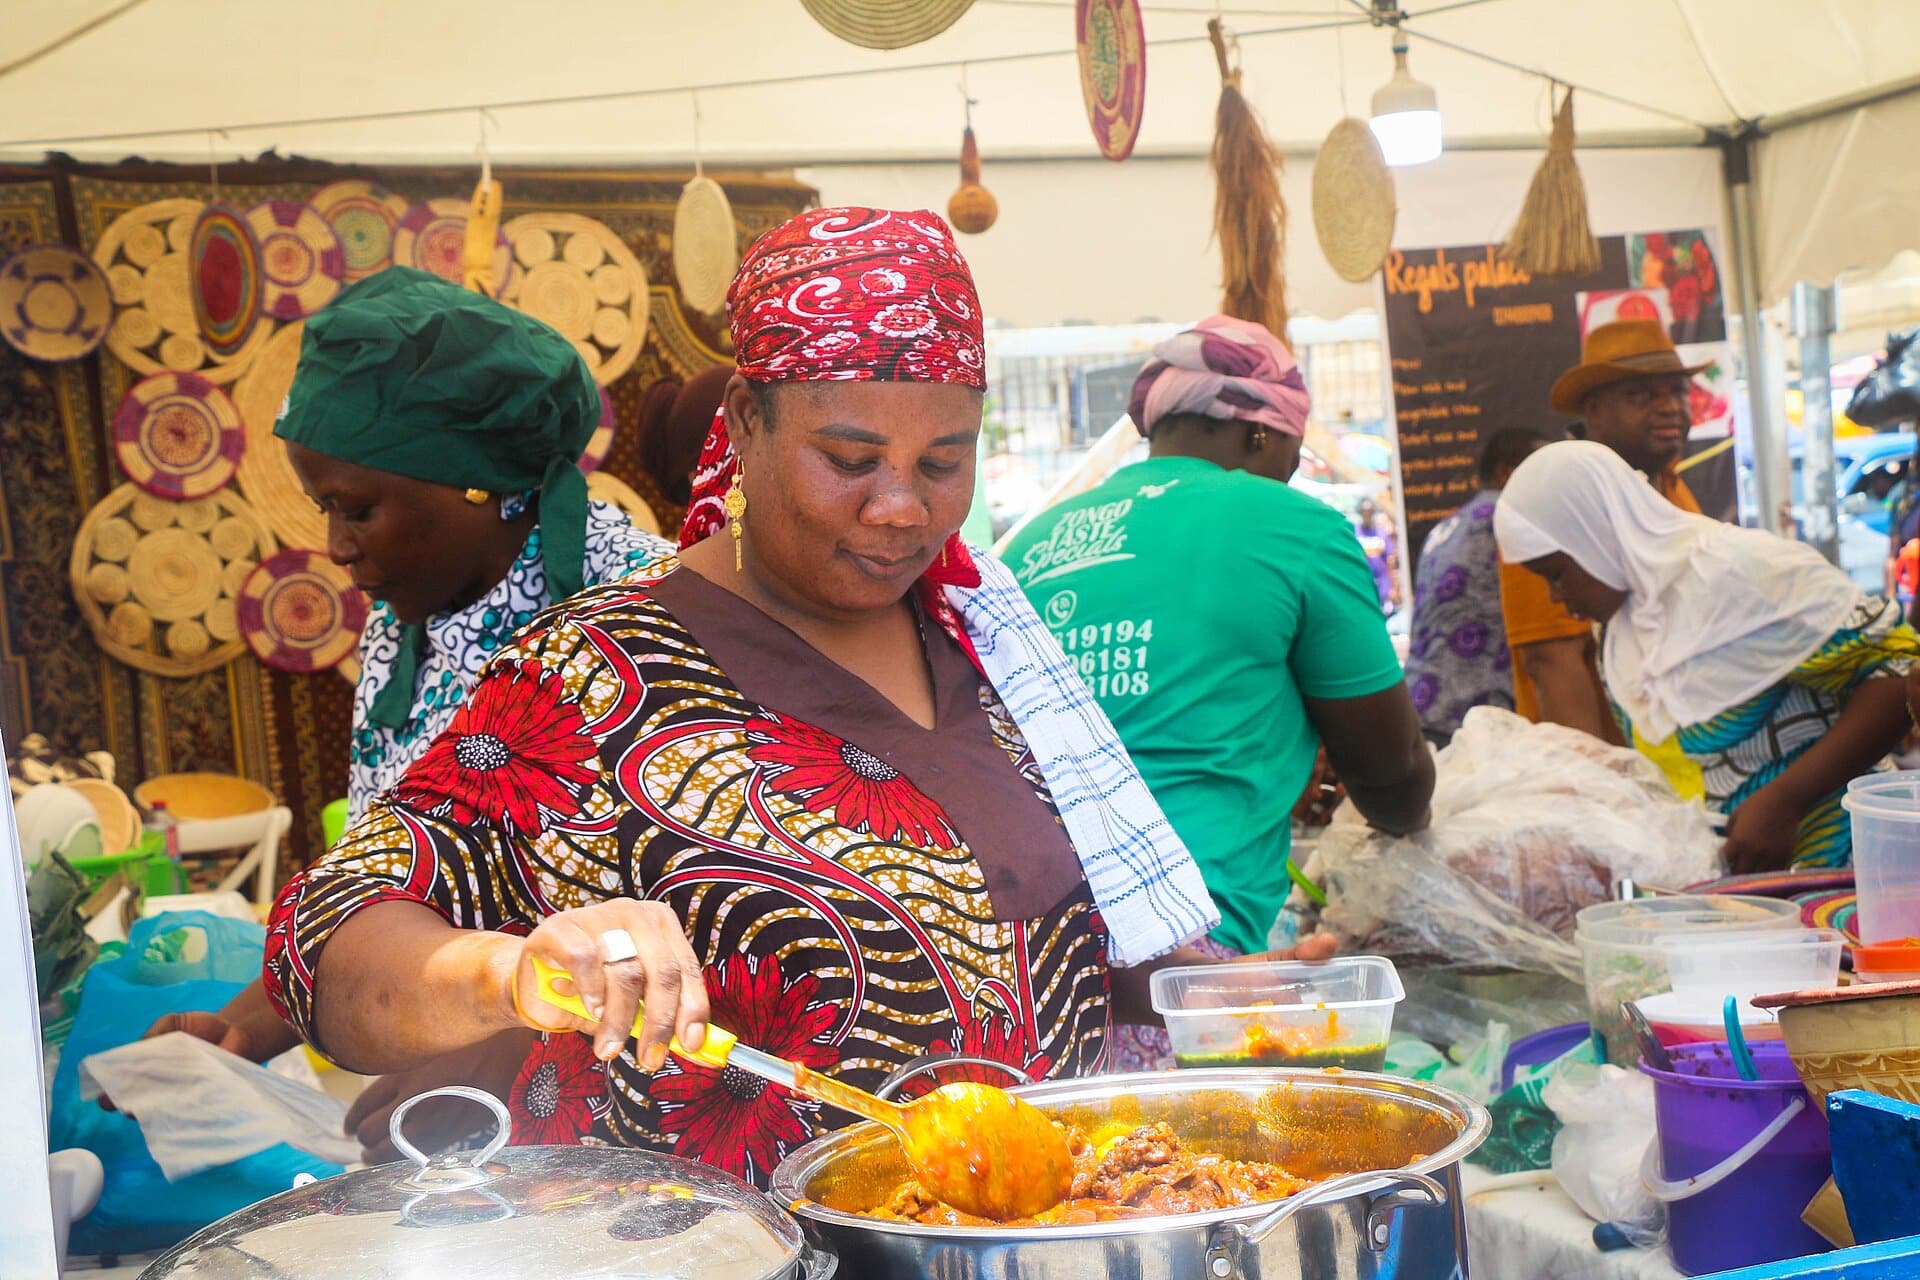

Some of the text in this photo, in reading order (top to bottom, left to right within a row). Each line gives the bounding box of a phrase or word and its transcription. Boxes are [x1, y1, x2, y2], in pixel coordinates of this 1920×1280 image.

[1384, 248, 1460, 314] Regals
[1049, 519, 1116, 552] TASTE
[1057, 499, 1133, 528] ZONGO
[1016, 525, 1128, 580] Specials
